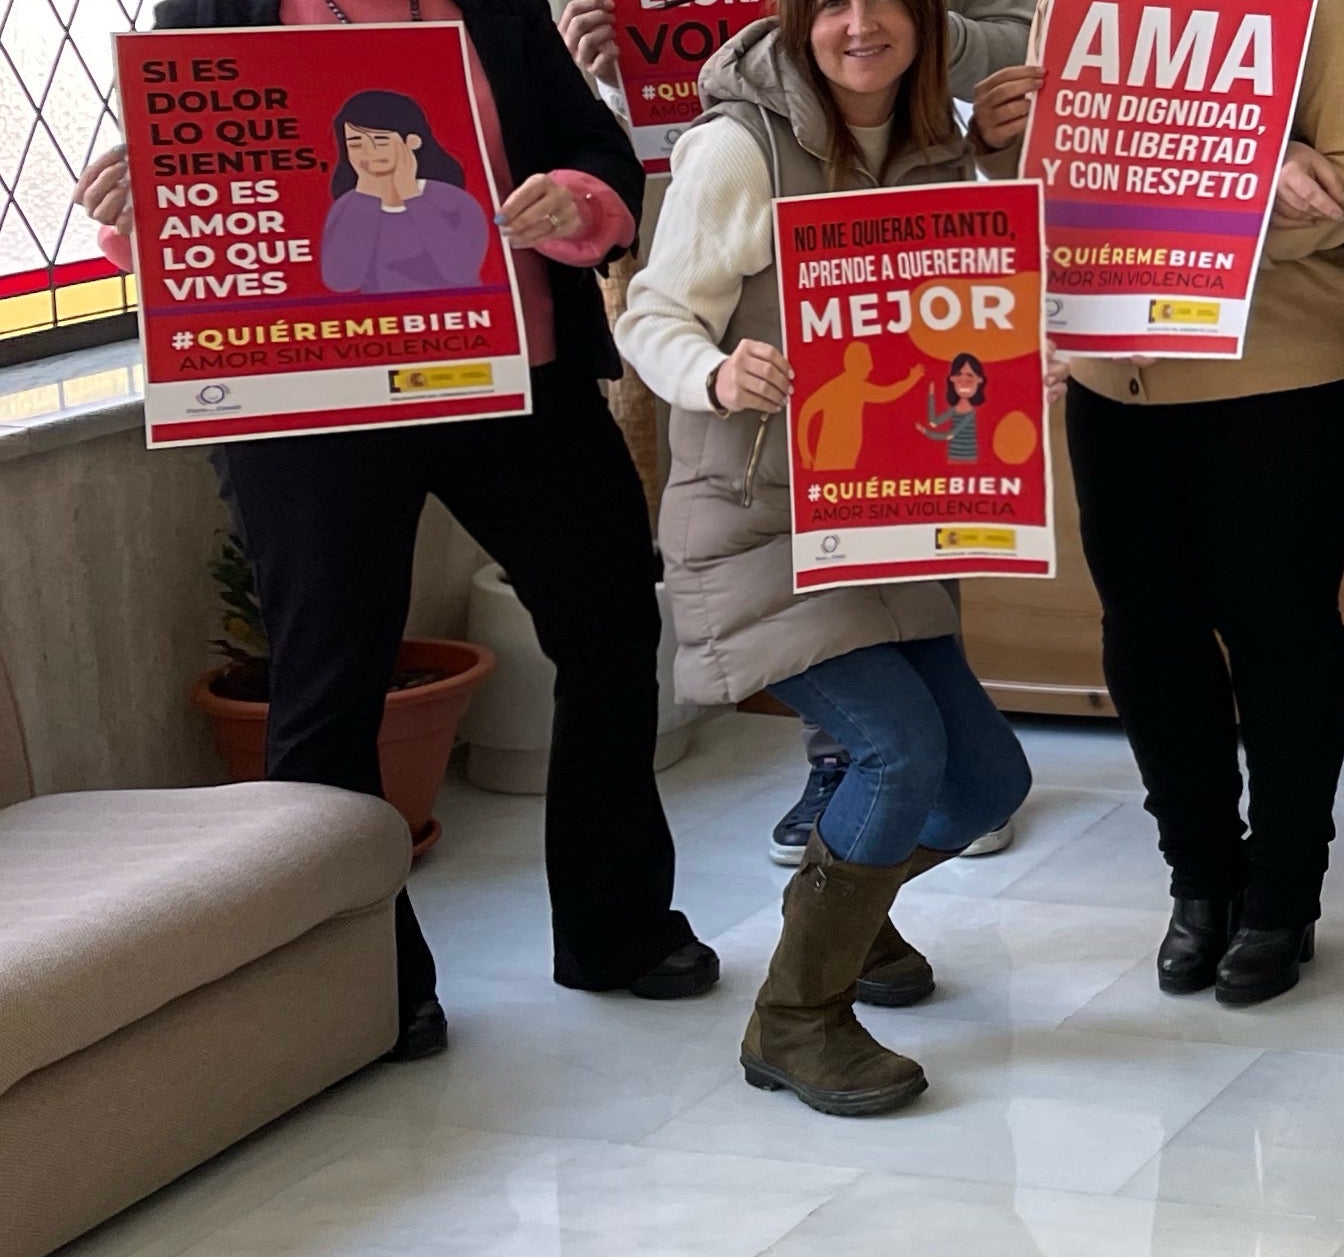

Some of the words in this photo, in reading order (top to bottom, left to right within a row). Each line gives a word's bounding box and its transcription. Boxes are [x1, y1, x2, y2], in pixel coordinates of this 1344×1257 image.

[1060, 1, 1274, 97] AMA
[142, 60, 178, 84] SI
[192, 58, 239, 82] ES
[147, 87, 289, 114] DOLOR
[1055, 89, 1112, 120] CON
[1117, 95, 1266, 136] DIGNIDAD,
[150, 121, 203, 145] LO
[217, 118, 299, 146] QUE
[1055, 125, 1111, 154] CON
[1115, 132, 1257, 166] LIBERTAD
[153, 147, 329, 177] SIENTES,
[157, 183, 225, 209] NO
[231, 179, 280, 204] ES
[1042, 159, 1061, 186] Y
[1070, 161, 1121, 191] CON
[1126, 167, 1258, 200] RESPETO
[159, 211, 285, 240] AMOR
[794, 227, 817, 252] NO
[822, 224, 847, 249] ME
[852, 215, 926, 247] QUIERAS
[931, 210, 1016, 241] TANTO,
[163, 244, 220, 270] LO
[226, 240, 313, 268] QUE
[798, 257, 874, 289] APRENDE
[881, 257, 895, 279] A
[899, 247, 1017, 279] QUERERME
[164, 272, 288, 301] VIVES
[1048, 270, 1094, 286] MOR
[1097, 271, 1124, 287] SIN
[1127, 271, 1224, 289] VIOLENCIA
[800, 284, 1016, 343] MEJOR
[171, 309, 492, 352] #QUIÉREMEBIEN
[179, 348, 271, 373] AMOR
[277, 345, 325, 366] SIN
[335, 333, 492, 361] VIOLENCIA
[808, 476, 1021, 503] #QUIÉREMEBIEN
[812, 505, 863, 522] AMOR
[868, 504, 899, 519] SIN
[905, 500, 1016, 517] VIOLENCIA
